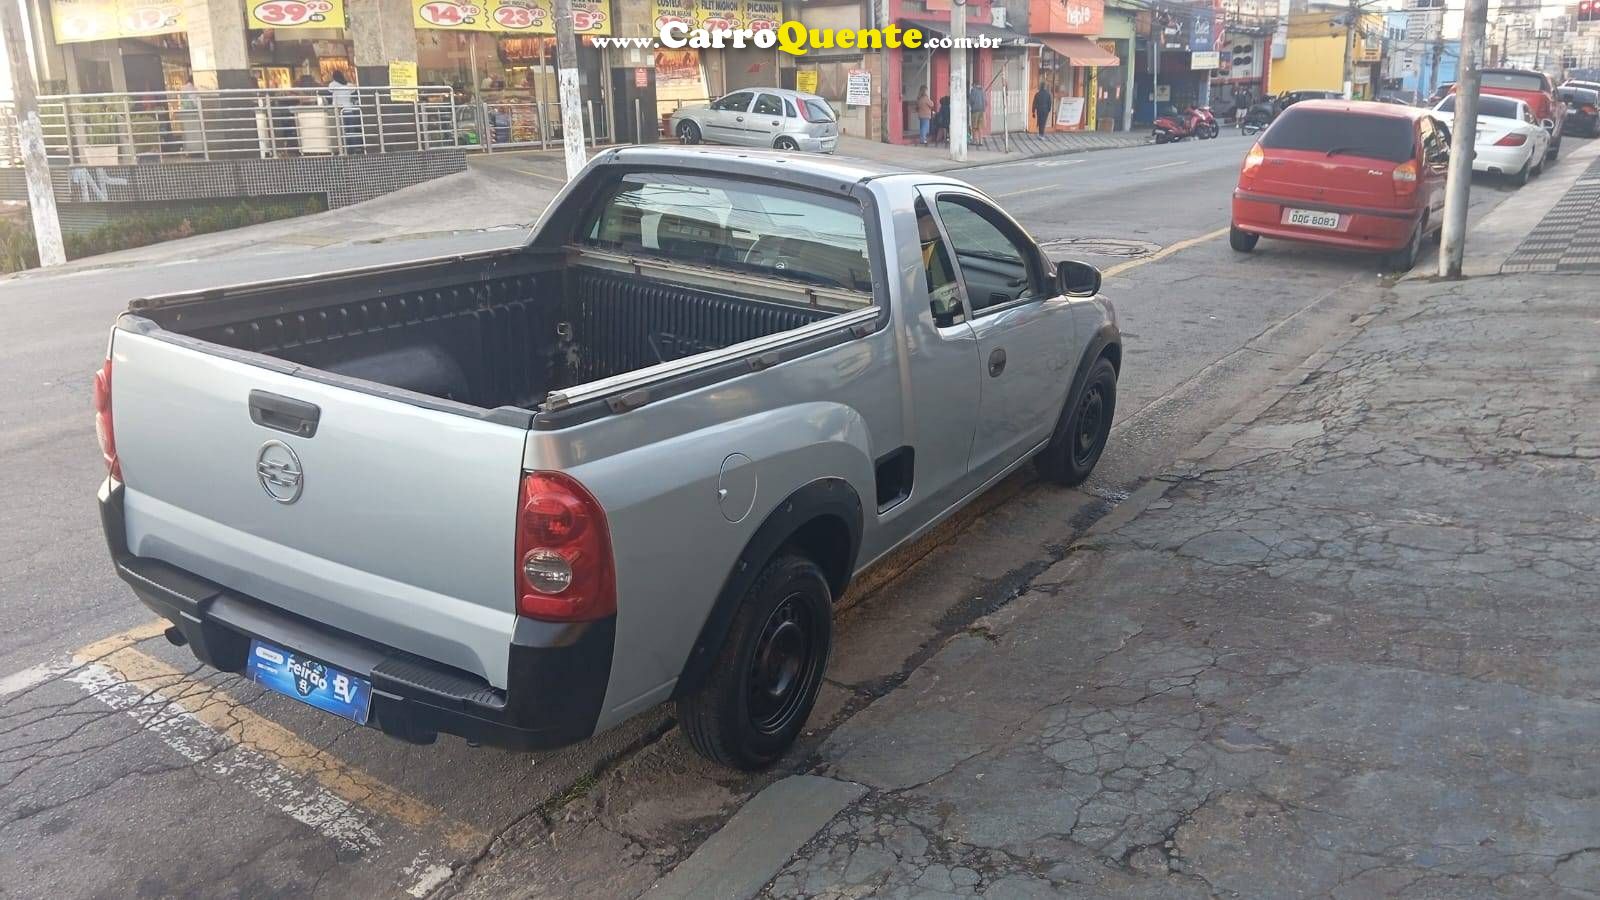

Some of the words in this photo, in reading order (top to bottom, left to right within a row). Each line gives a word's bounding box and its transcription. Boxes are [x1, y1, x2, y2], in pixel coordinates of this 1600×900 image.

[262, 4, 307, 22] 39
[427, 5, 461, 22] 14
[747, 3, 779, 13] PICANHA
[499, 9, 531, 25] 23
[286, 657, 328, 690] Feirão
